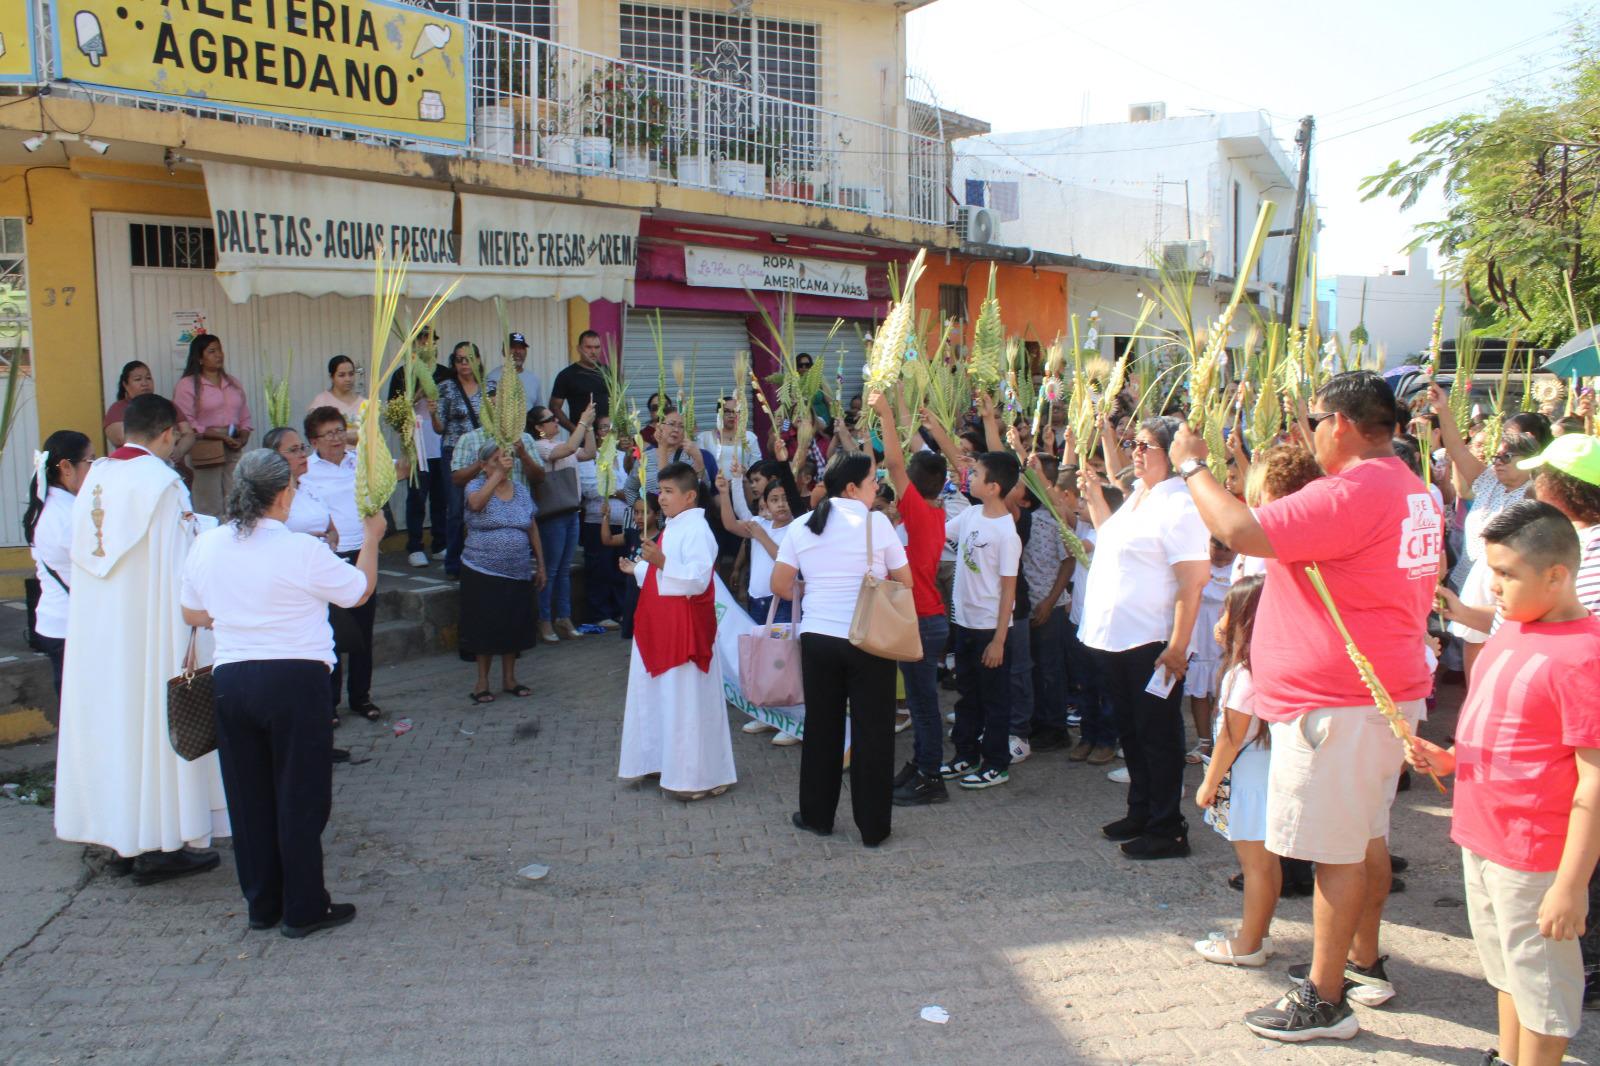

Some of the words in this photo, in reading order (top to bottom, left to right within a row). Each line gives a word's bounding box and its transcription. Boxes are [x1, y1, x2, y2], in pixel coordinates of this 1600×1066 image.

[160, 0, 379, 51] LETERIA
[152, 21, 398, 106] AGREDANO
[216, 209, 312, 257] PALETAS
[323, 219, 384, 260] AGUAS
[391, 225, 459, 264] FRESCAS
[478, 230, 529, 266] NIEVES
[537, 233, 586, 266] FRESAS
[762, 255, 795, 270] ROPA
[763, 275, 829, 293] AMERICANA
[832, 281, 839, 294] Y
